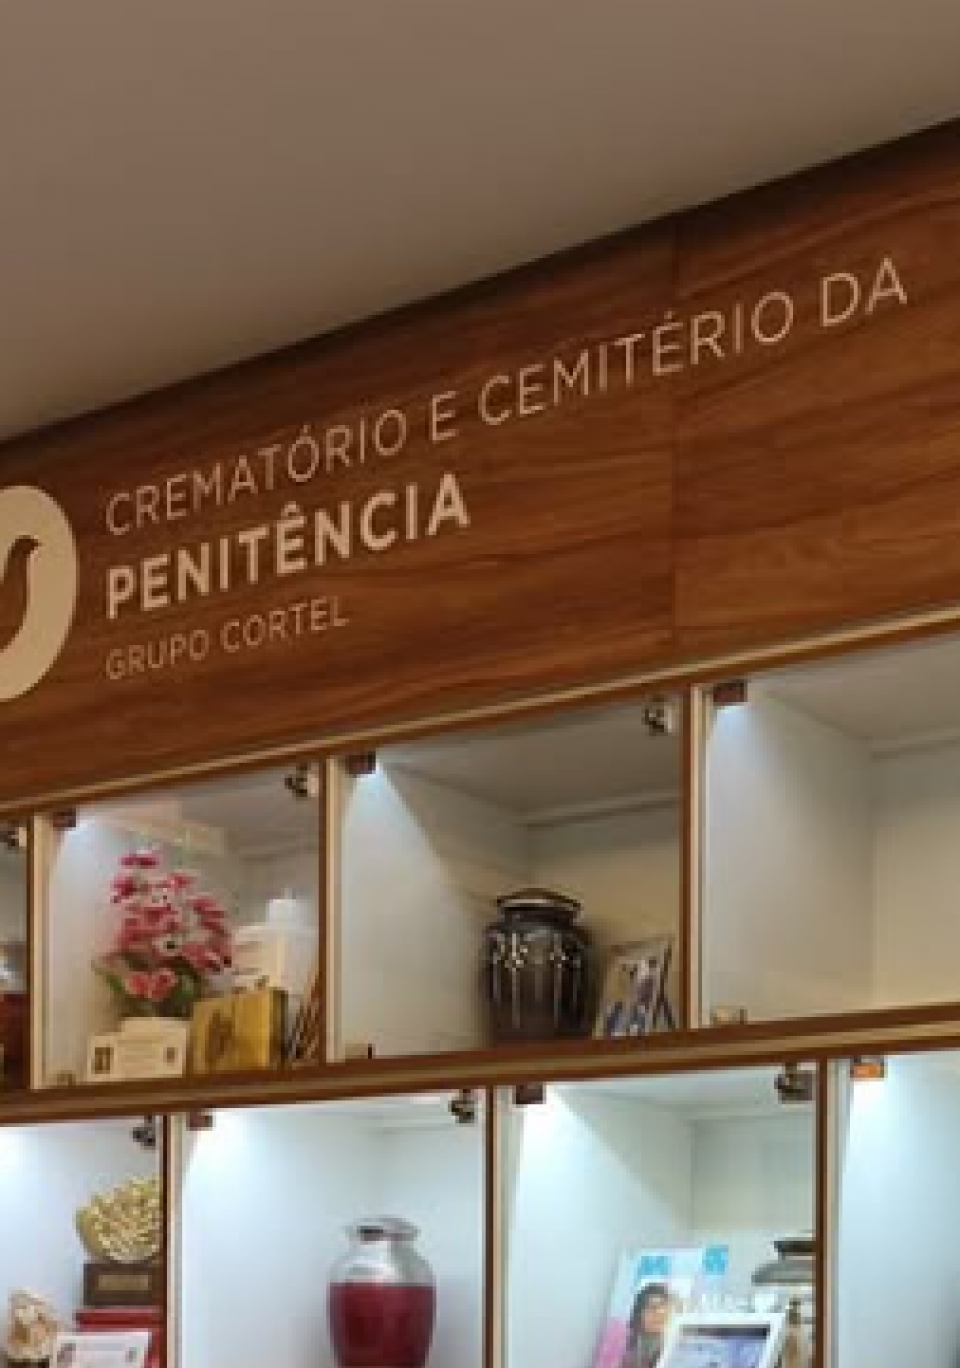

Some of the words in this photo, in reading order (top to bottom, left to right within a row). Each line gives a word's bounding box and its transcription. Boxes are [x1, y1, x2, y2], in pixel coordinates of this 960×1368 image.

[105, 409, 407, 536] CREMATÓRIO
[430, 390, 459, 443] E
[478, 291, 794, 426] CEMITÉRIO
[819, 257, 908, 327] DA
[106, 472, 471, 620] PENITÊNCIA
[105, 629, 210, 680] GRUPO
[219, 595, 350, 652] CORTEL
